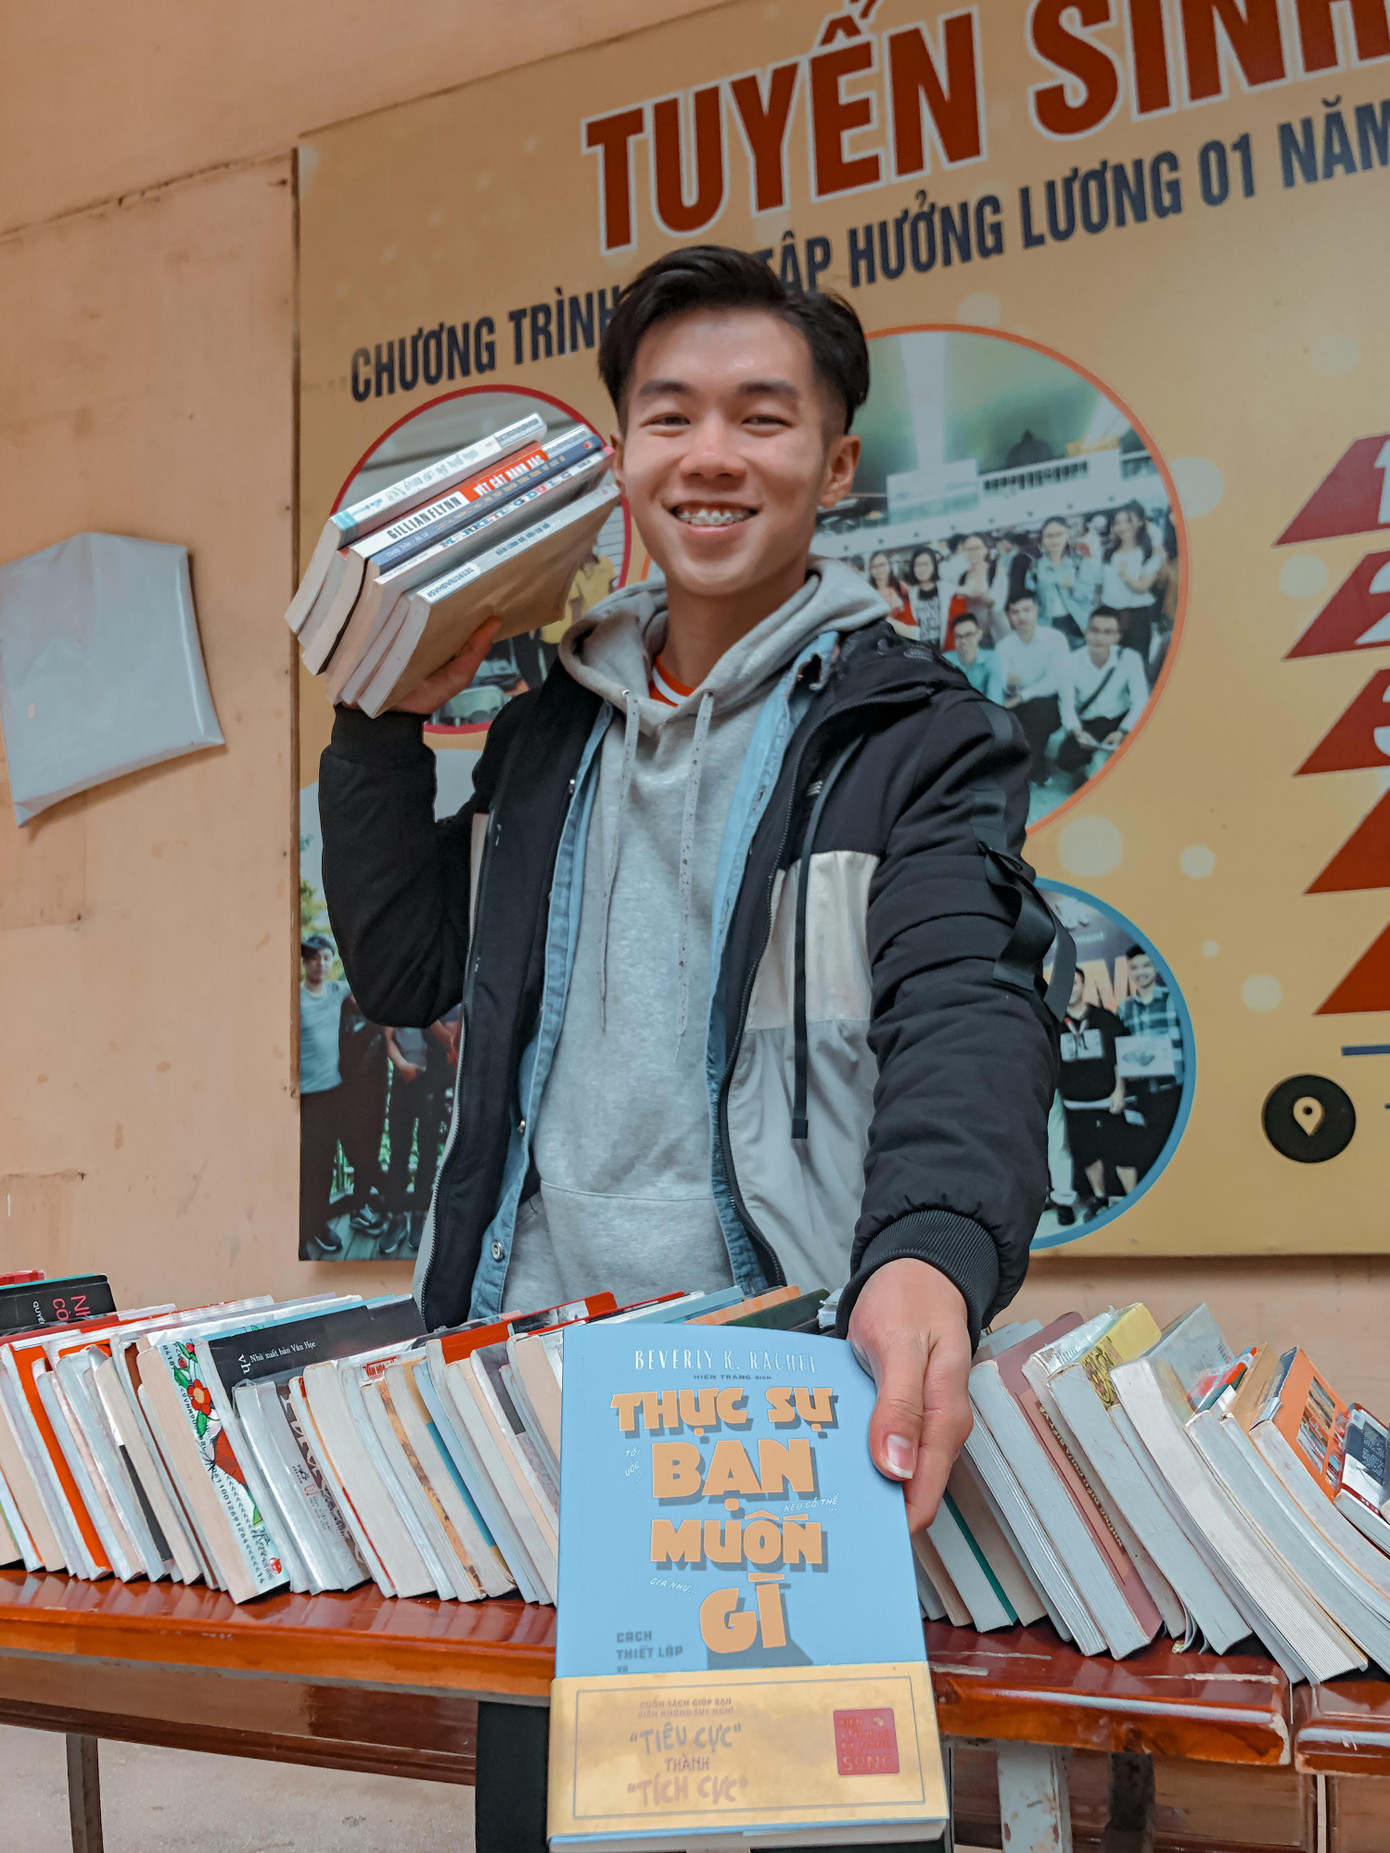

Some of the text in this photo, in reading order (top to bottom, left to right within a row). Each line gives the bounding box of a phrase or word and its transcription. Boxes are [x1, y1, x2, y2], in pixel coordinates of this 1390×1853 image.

[581, 0, 1390, 255] TUYỂN SINH
[350, 316, 496, 402] CHƯƠNG
[847, 190, 1004, 288] HƯỞNG
[1019, 151, 1183, 249] LƯƠNG
[1198, 132, 1255, 207] 01
[385, 508, 433, 541] GILLIAN
[426, 494, 463, 520] FLYNN
[635, 1349, 818, 1373] BEVERLY K. RACHEL
[651, 1439, 815, 1511] BẠN
[650, 1509, 823, 1564] MUỐN
